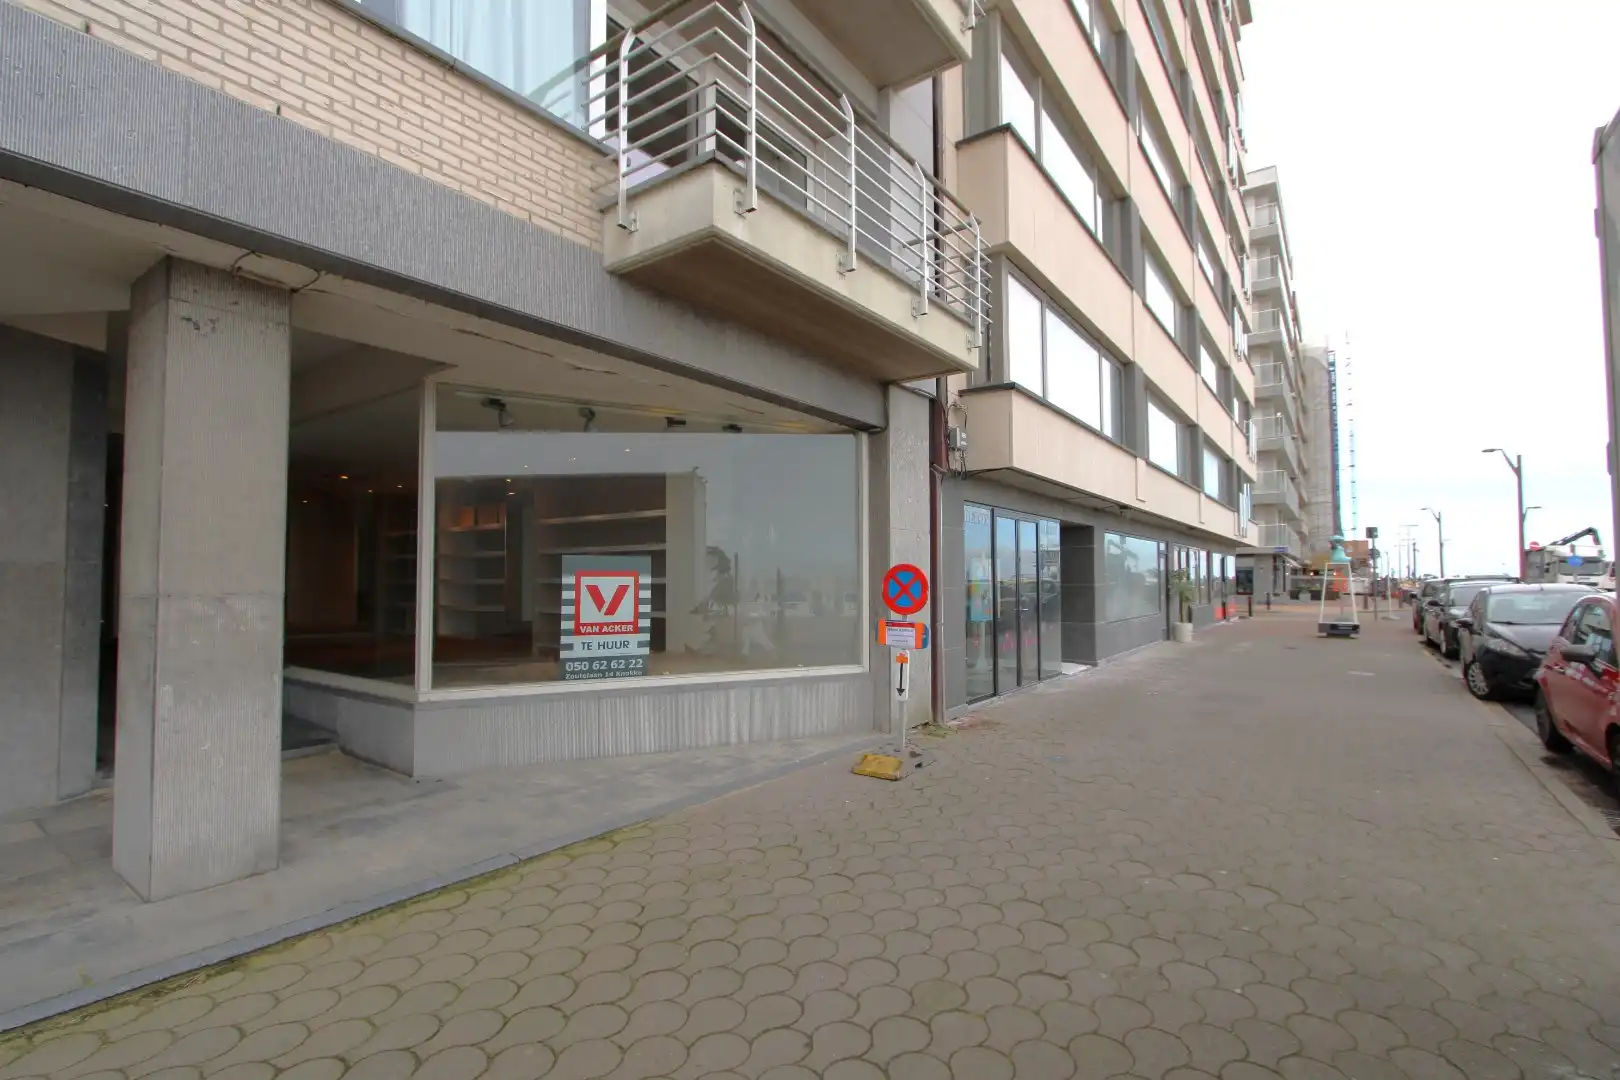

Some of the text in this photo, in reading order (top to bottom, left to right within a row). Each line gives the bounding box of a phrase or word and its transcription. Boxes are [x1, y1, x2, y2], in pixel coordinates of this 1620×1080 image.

[580, 624, 634, 633] VAN ACKER
[581, 640, 630, 651] TE HUUR
[565, 658, 644, 671] 050 62 62 22
[565, 672, 603, 680] Zoutelaan
